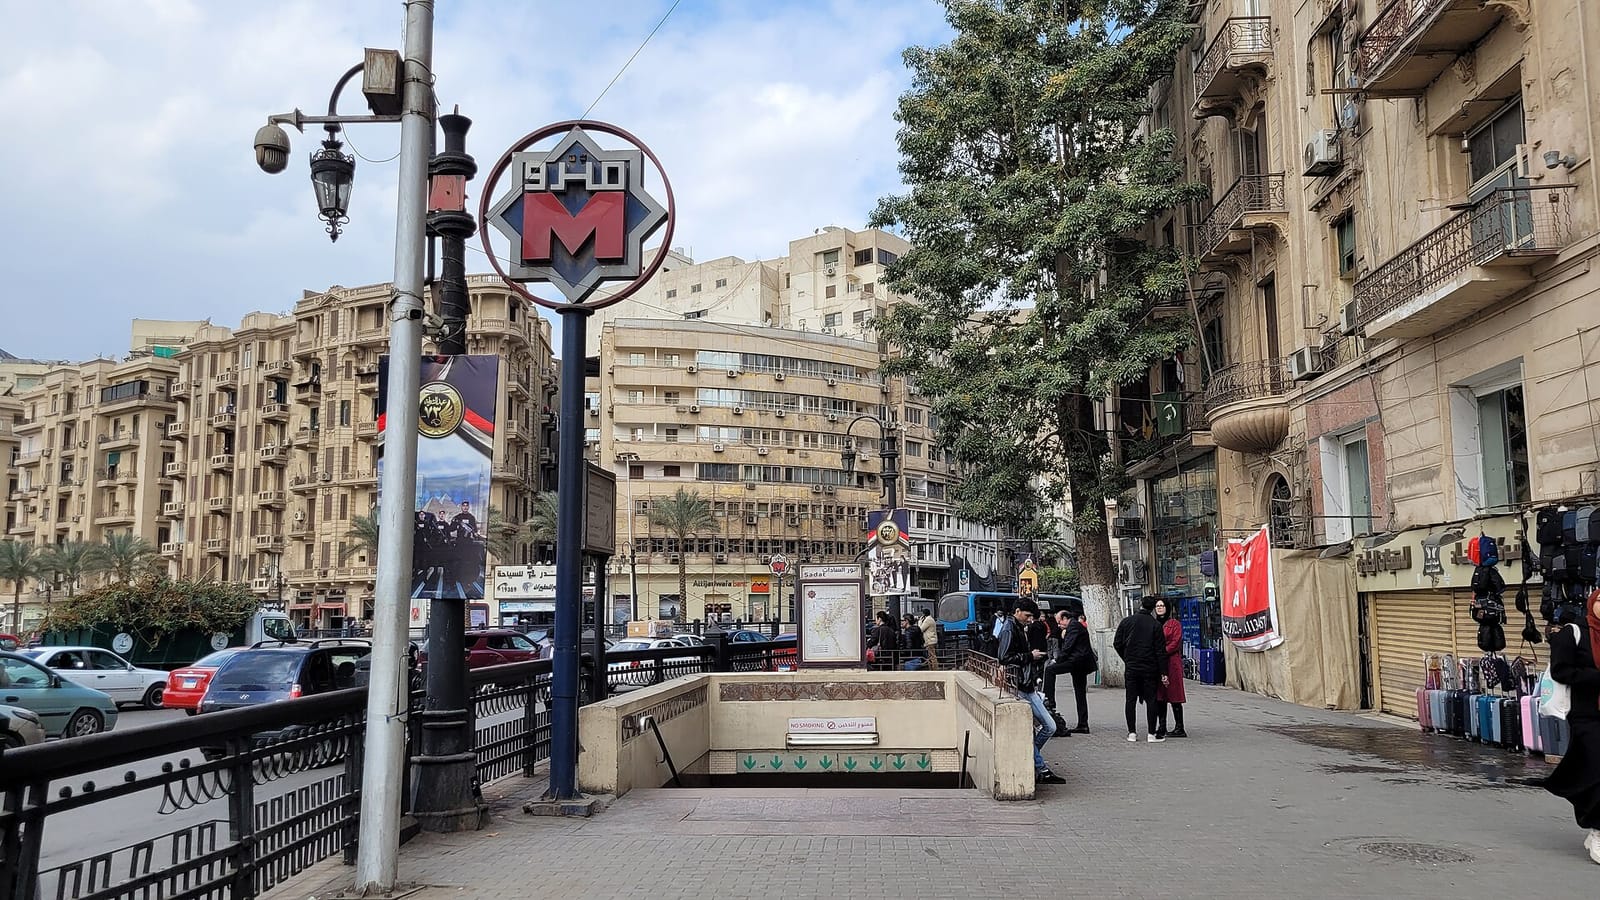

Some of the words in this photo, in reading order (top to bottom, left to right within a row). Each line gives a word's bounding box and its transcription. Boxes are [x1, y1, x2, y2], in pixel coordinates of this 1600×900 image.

[524, 154, 626, 191] مترو
[522, 191, 626, 260] M
[497, 569, 524, 580] للسياحة
[837, 720, 857, 729] التدخين
[857, 721, 874, 729] ممنوع
